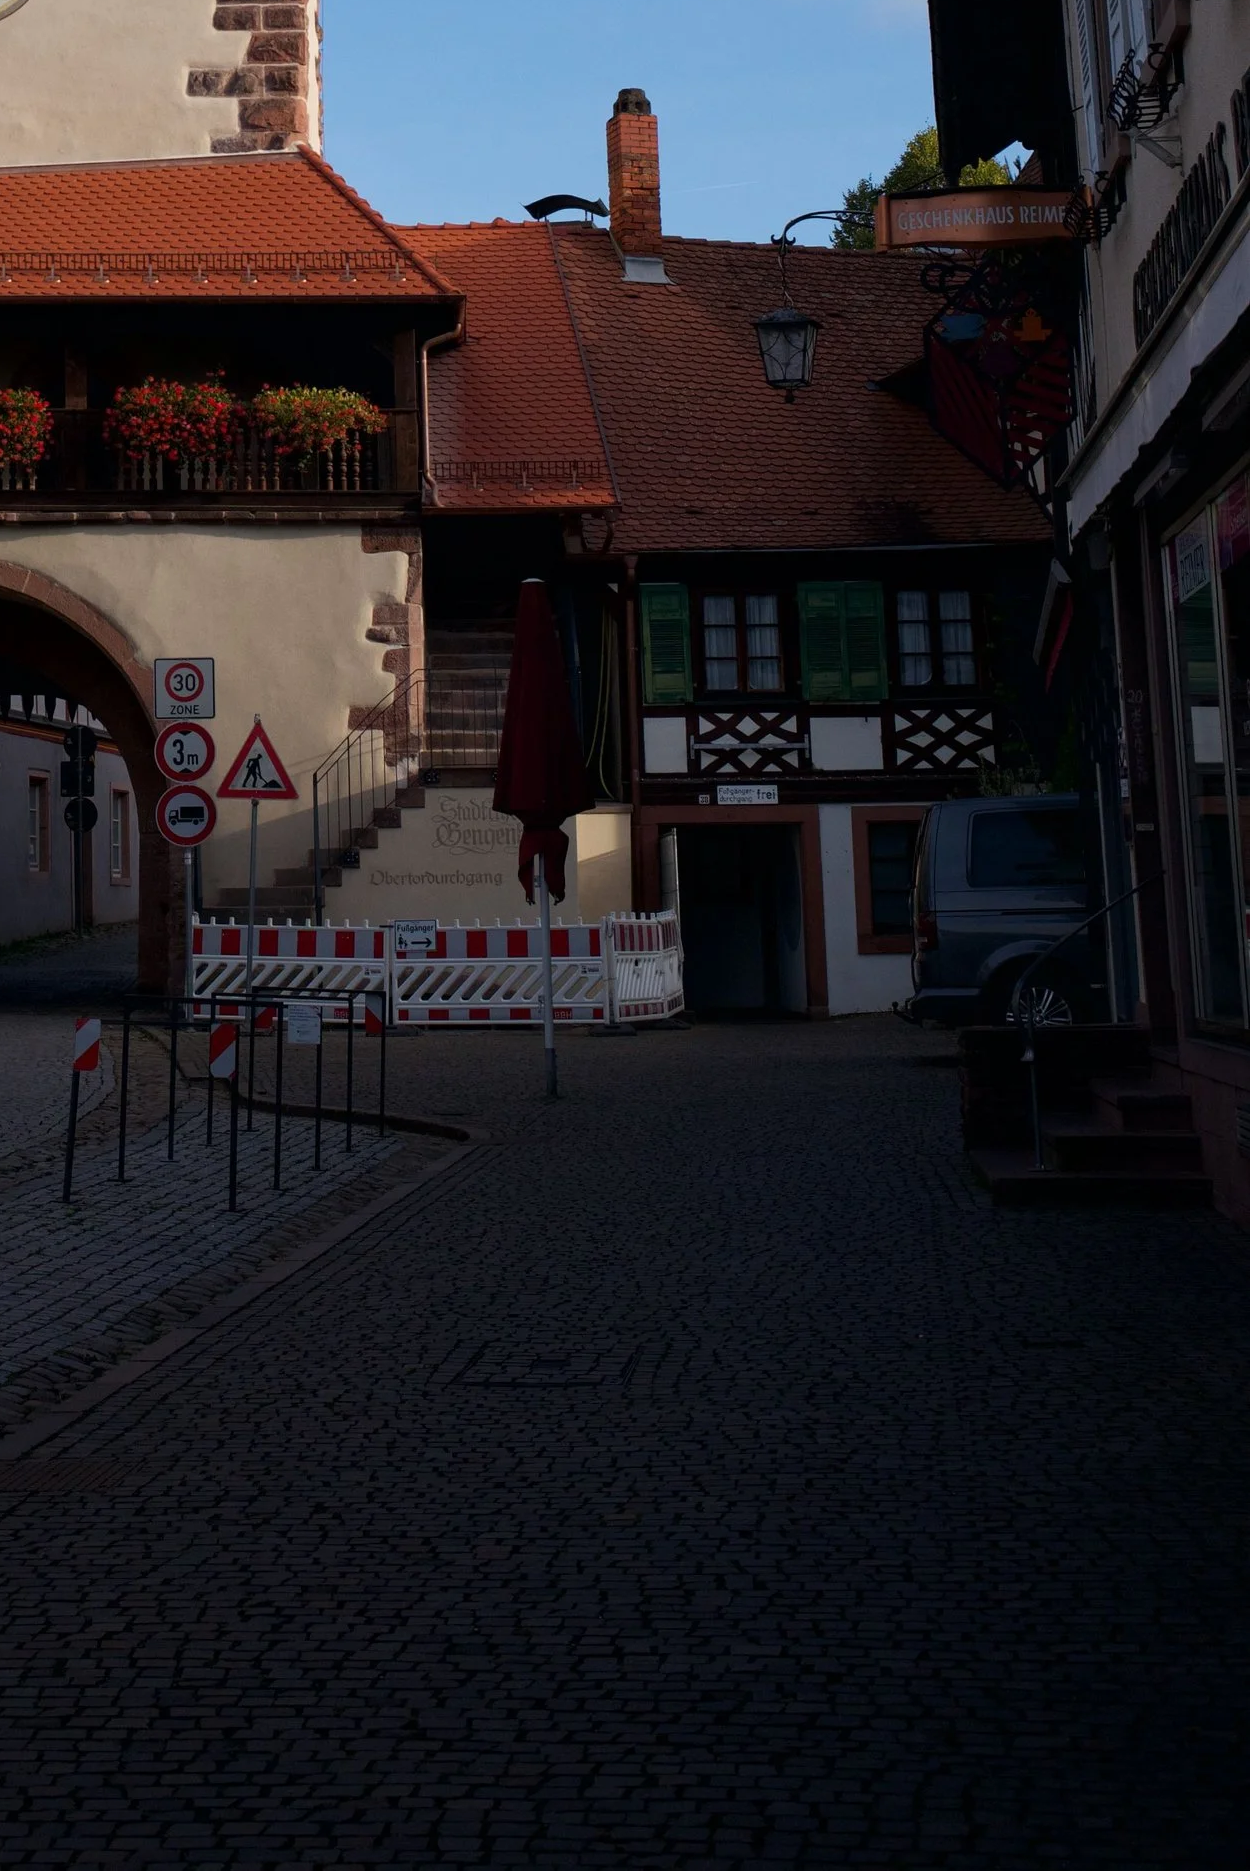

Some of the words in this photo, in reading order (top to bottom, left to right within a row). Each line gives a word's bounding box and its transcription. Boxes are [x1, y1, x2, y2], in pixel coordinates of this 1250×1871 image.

[897, 206, 1015, 230] GESCHENKHAUS
[1019, 205, 1066, 224] REIME
[173, 674, 196, 691] 30
[170, 705, 200, 715] ZONE
[757, 789, 776, 800] frei
[370, 870, 503, 886] Obertordurchgang
[397, 924, 434, 933] Fußgänger
